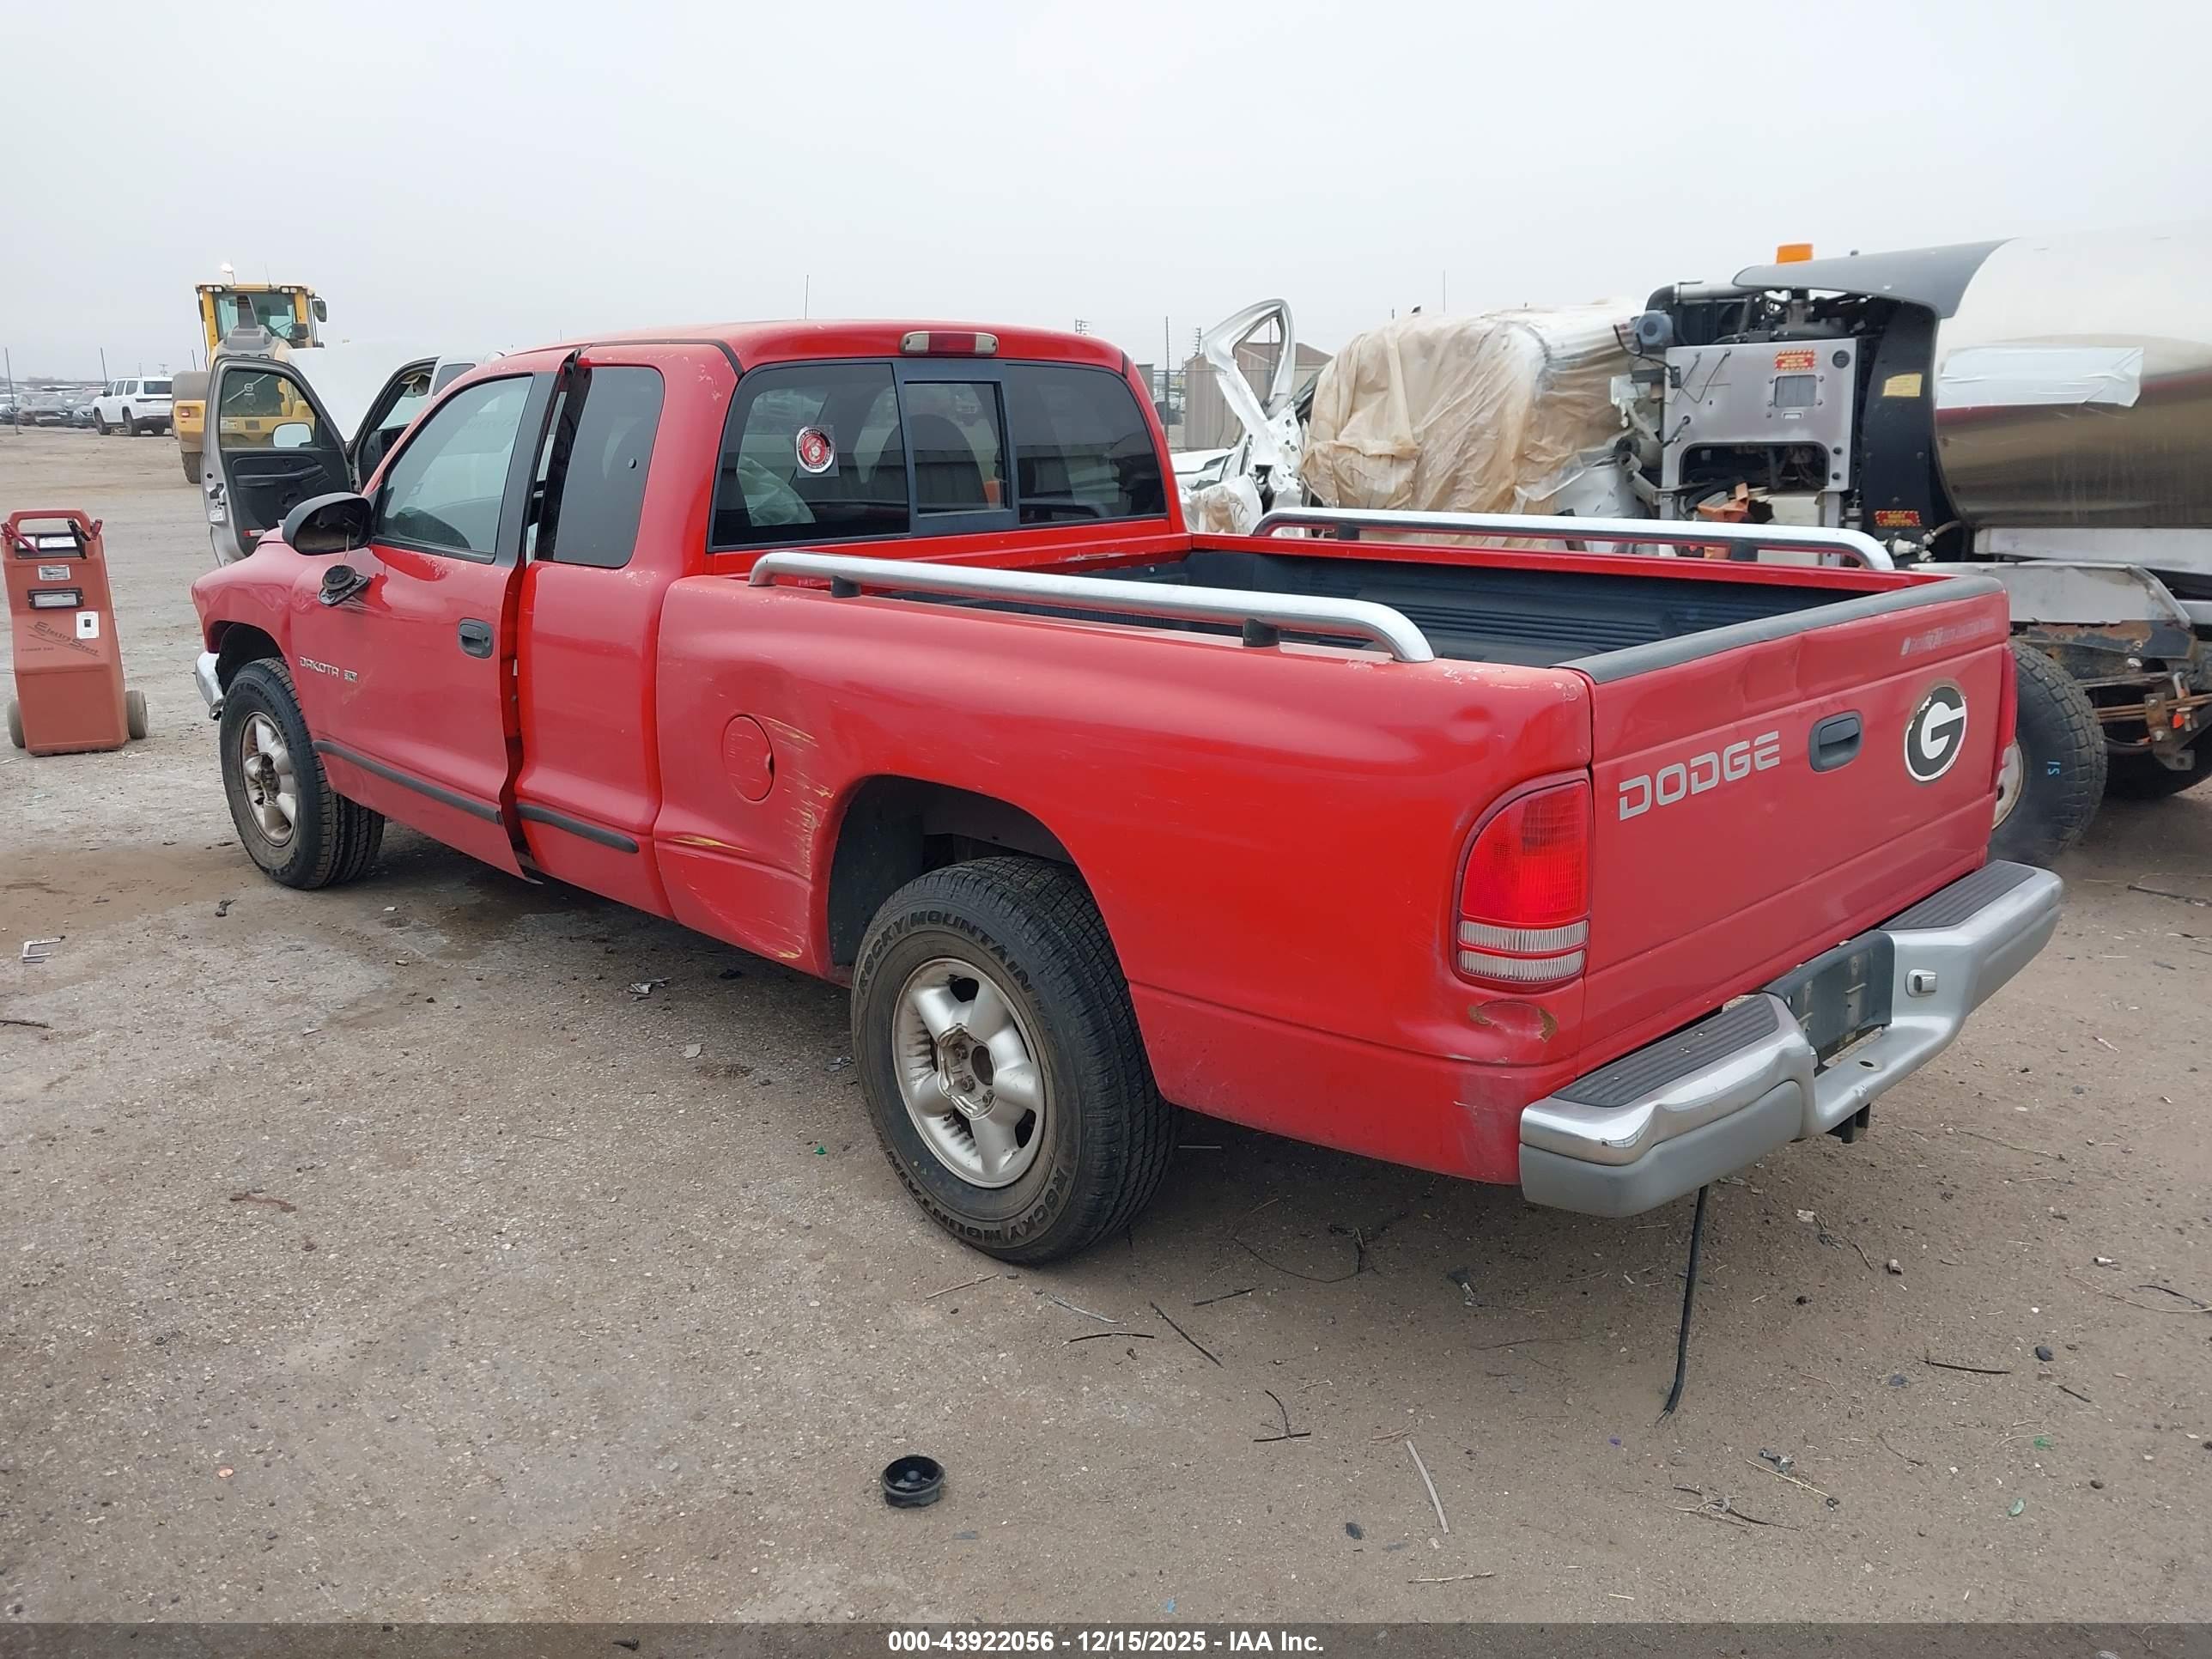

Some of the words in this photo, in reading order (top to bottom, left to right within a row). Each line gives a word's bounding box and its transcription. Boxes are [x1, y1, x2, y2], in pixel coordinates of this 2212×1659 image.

[299, 655, 340, 678] DAKOTA
[1620, 730, 1780, 821] DODGE
[860, 915, 907, 996] ROCKY
[909, 910, 1031, 994] MOUNTAIN
[1010, 1166, 1068, 1243] ROCKY
